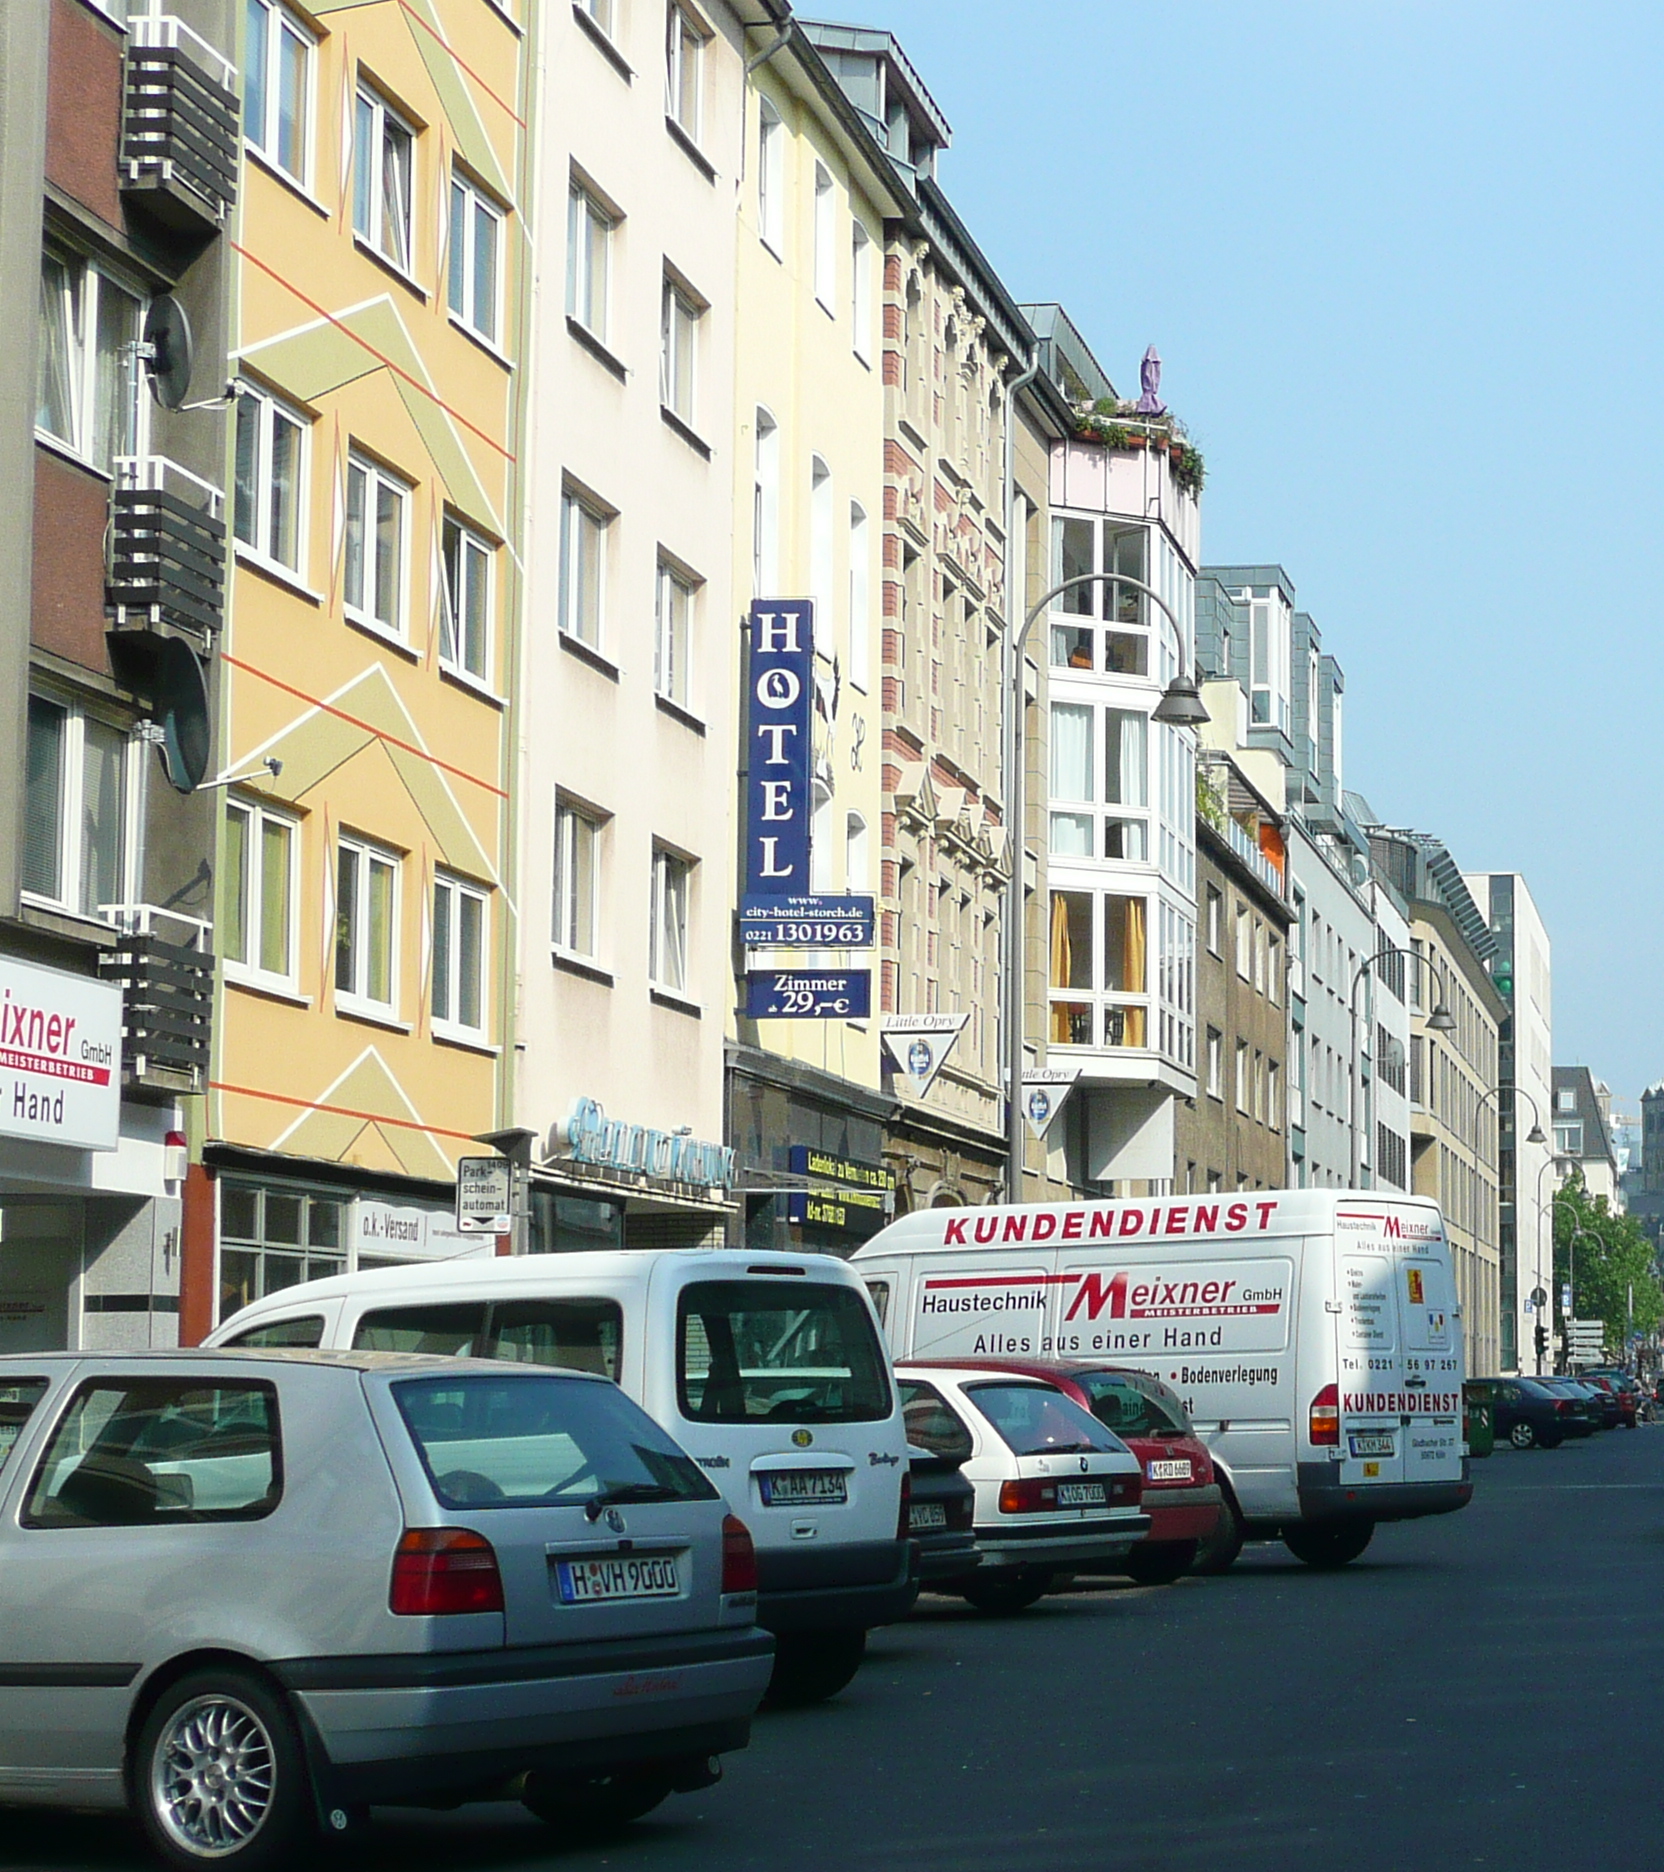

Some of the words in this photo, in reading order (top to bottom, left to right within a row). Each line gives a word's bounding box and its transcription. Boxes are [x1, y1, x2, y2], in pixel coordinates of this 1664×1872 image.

[757, 613, 802, 877] HOTEL
[746, 906, 863, 918] city-hotel-storch.de
[745, 930, 772, 940] 0221
[776, 924, 864, 941] 1301963
[773, 974, 847, 991] Zimmer
[885, 1014, 919, 1028] Little
[923, 1014, 955, 1030] Opry
[81, 1039, 113, 1066] GmbH
[1042, 1069, 1070, 1082] Opry
[13, 1080, 64, 1125] Hand
[463, 1165, 493, 1178] Park-
[463, 1181, 502, 1194] schein-
[462, 1200, 505, 1211] automat
[943, 1202, 1278, 1245] KUNDENDIENST
[1383, 1215, 1429, 1238] Meixner
[922, 1290, 1047, 1314] Haustechnik
[1065, 1271, 1237, 1322] Meixner
[1243, 1288, 1282, 1302] GmbH
[1144, 1305, 1258, 1318] MEISTERBETRIEB
[973, 1333, 1031, 1354] Alles
[1043, 1334, 1080, 1352] aus
[1092, 1331, 1151, 1350] einer
[1164, 1326, 1222, 1347] Hand
[1368, 1359, 1393, 1370] 0221
[1407, 1359, 1420, 1370] 56
[1424, 1359, 1436, 1370] 97
[1440, 1359, 1458, 1370] 267
[1181, 1365, 1279, 1386] Bodenverlegung
[1343, 1393, 1459, 1412] KUNDENDIENST
[812, 1473, 844, 1493] 7134
[572, 1565, 588, 1595] H
[599, 1562, 627, 1593] VH
[628, 1559, 677, 1591] 9000
